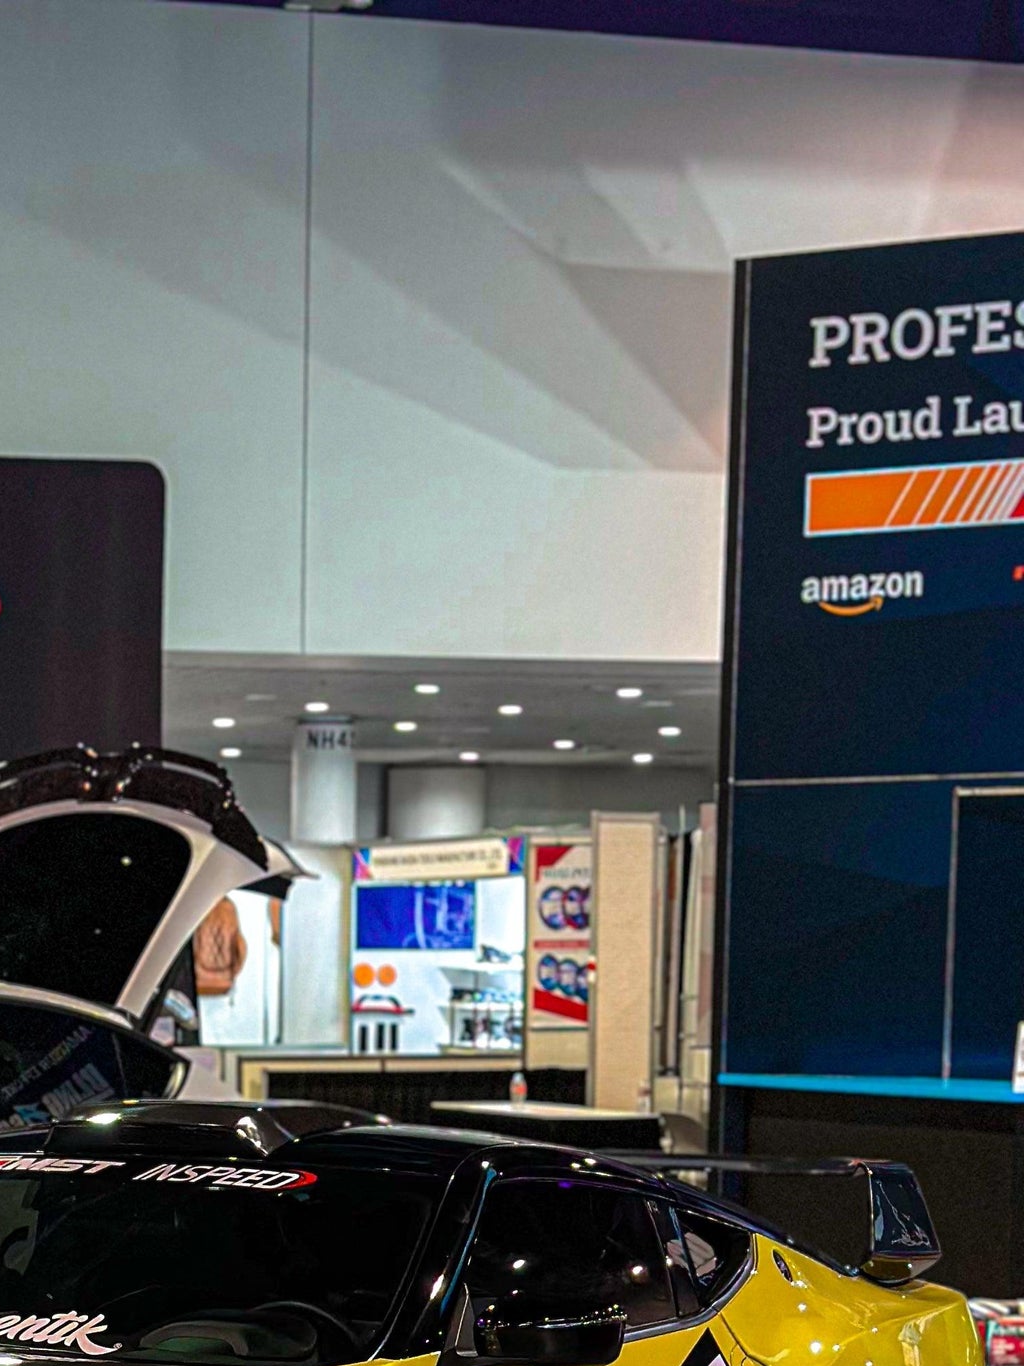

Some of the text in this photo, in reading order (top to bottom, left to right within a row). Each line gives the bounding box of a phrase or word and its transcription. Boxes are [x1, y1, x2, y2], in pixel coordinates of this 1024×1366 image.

[806, 396, 942, 448] Proud
[801, 571, 924, 603] amazon
[306, 729, 355, 751] NH4
[132, 1163, 300, 1190] INSPEED
